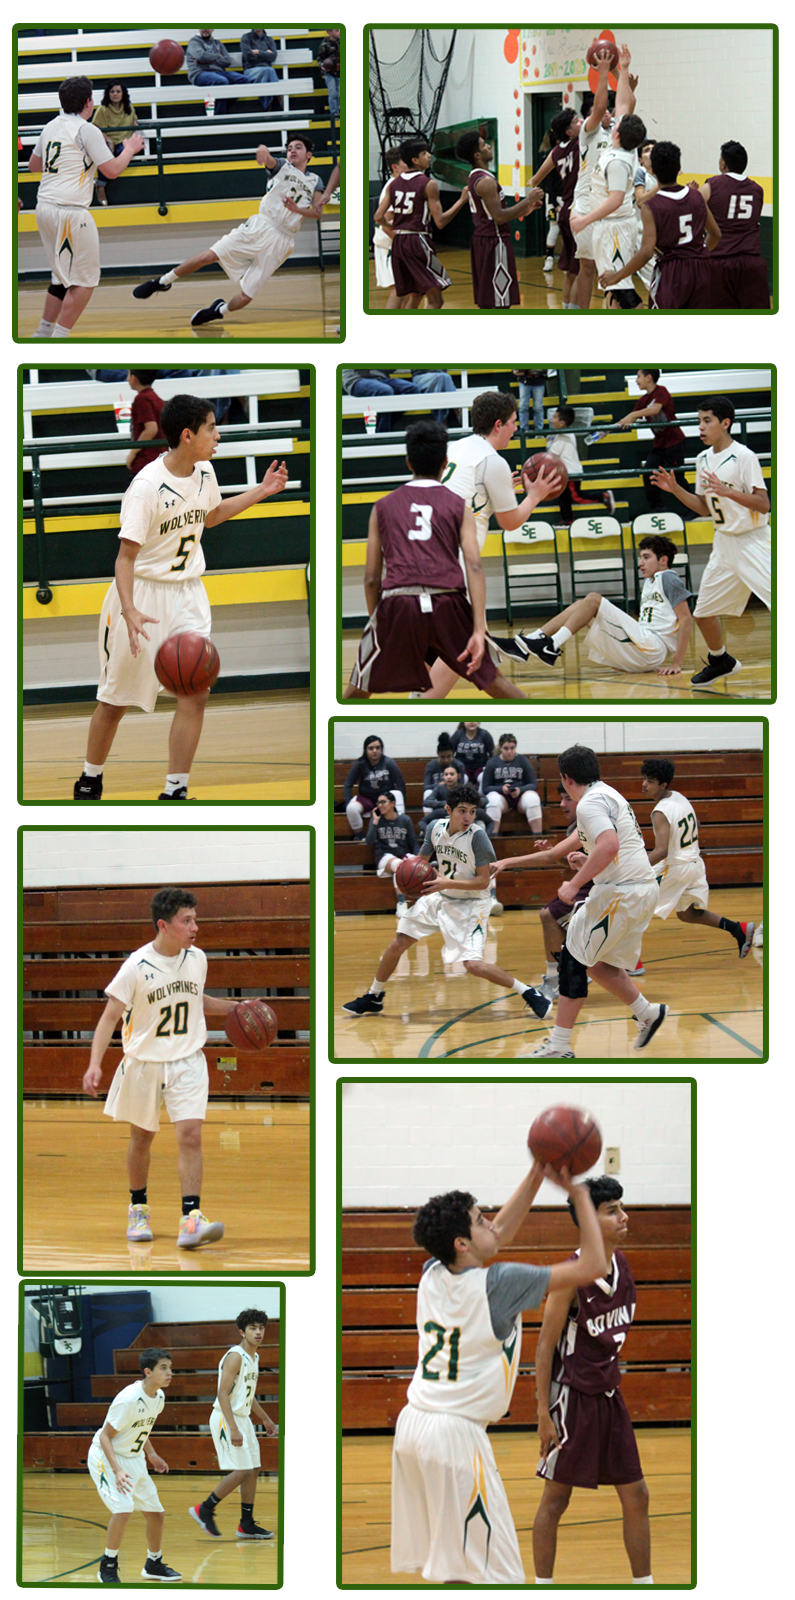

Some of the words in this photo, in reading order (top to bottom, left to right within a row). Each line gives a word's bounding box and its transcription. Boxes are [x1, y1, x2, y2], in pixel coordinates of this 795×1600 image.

[44, 141, 62, 174] 12
[393, 190, 417, 215] 25
[727, 194, 754, 220] 15
[677, 213, 694, 246] 5
[407, 502, 434, 542] 3
[650, 515, 667, 531] SE
[711, 496, 726, 525] 5
[521, 524, 538, 540] SE
[587, 519, 604, 535] SE
[170, 533, 197, 572] 5
[494, 766, 524, 780] HART
[677, 811, 698, 850] 22
[155, 1000, 190, 1038] 20
[421, 1320, 462, 1382] 21
[130, 1430, 150, 1454] 5
